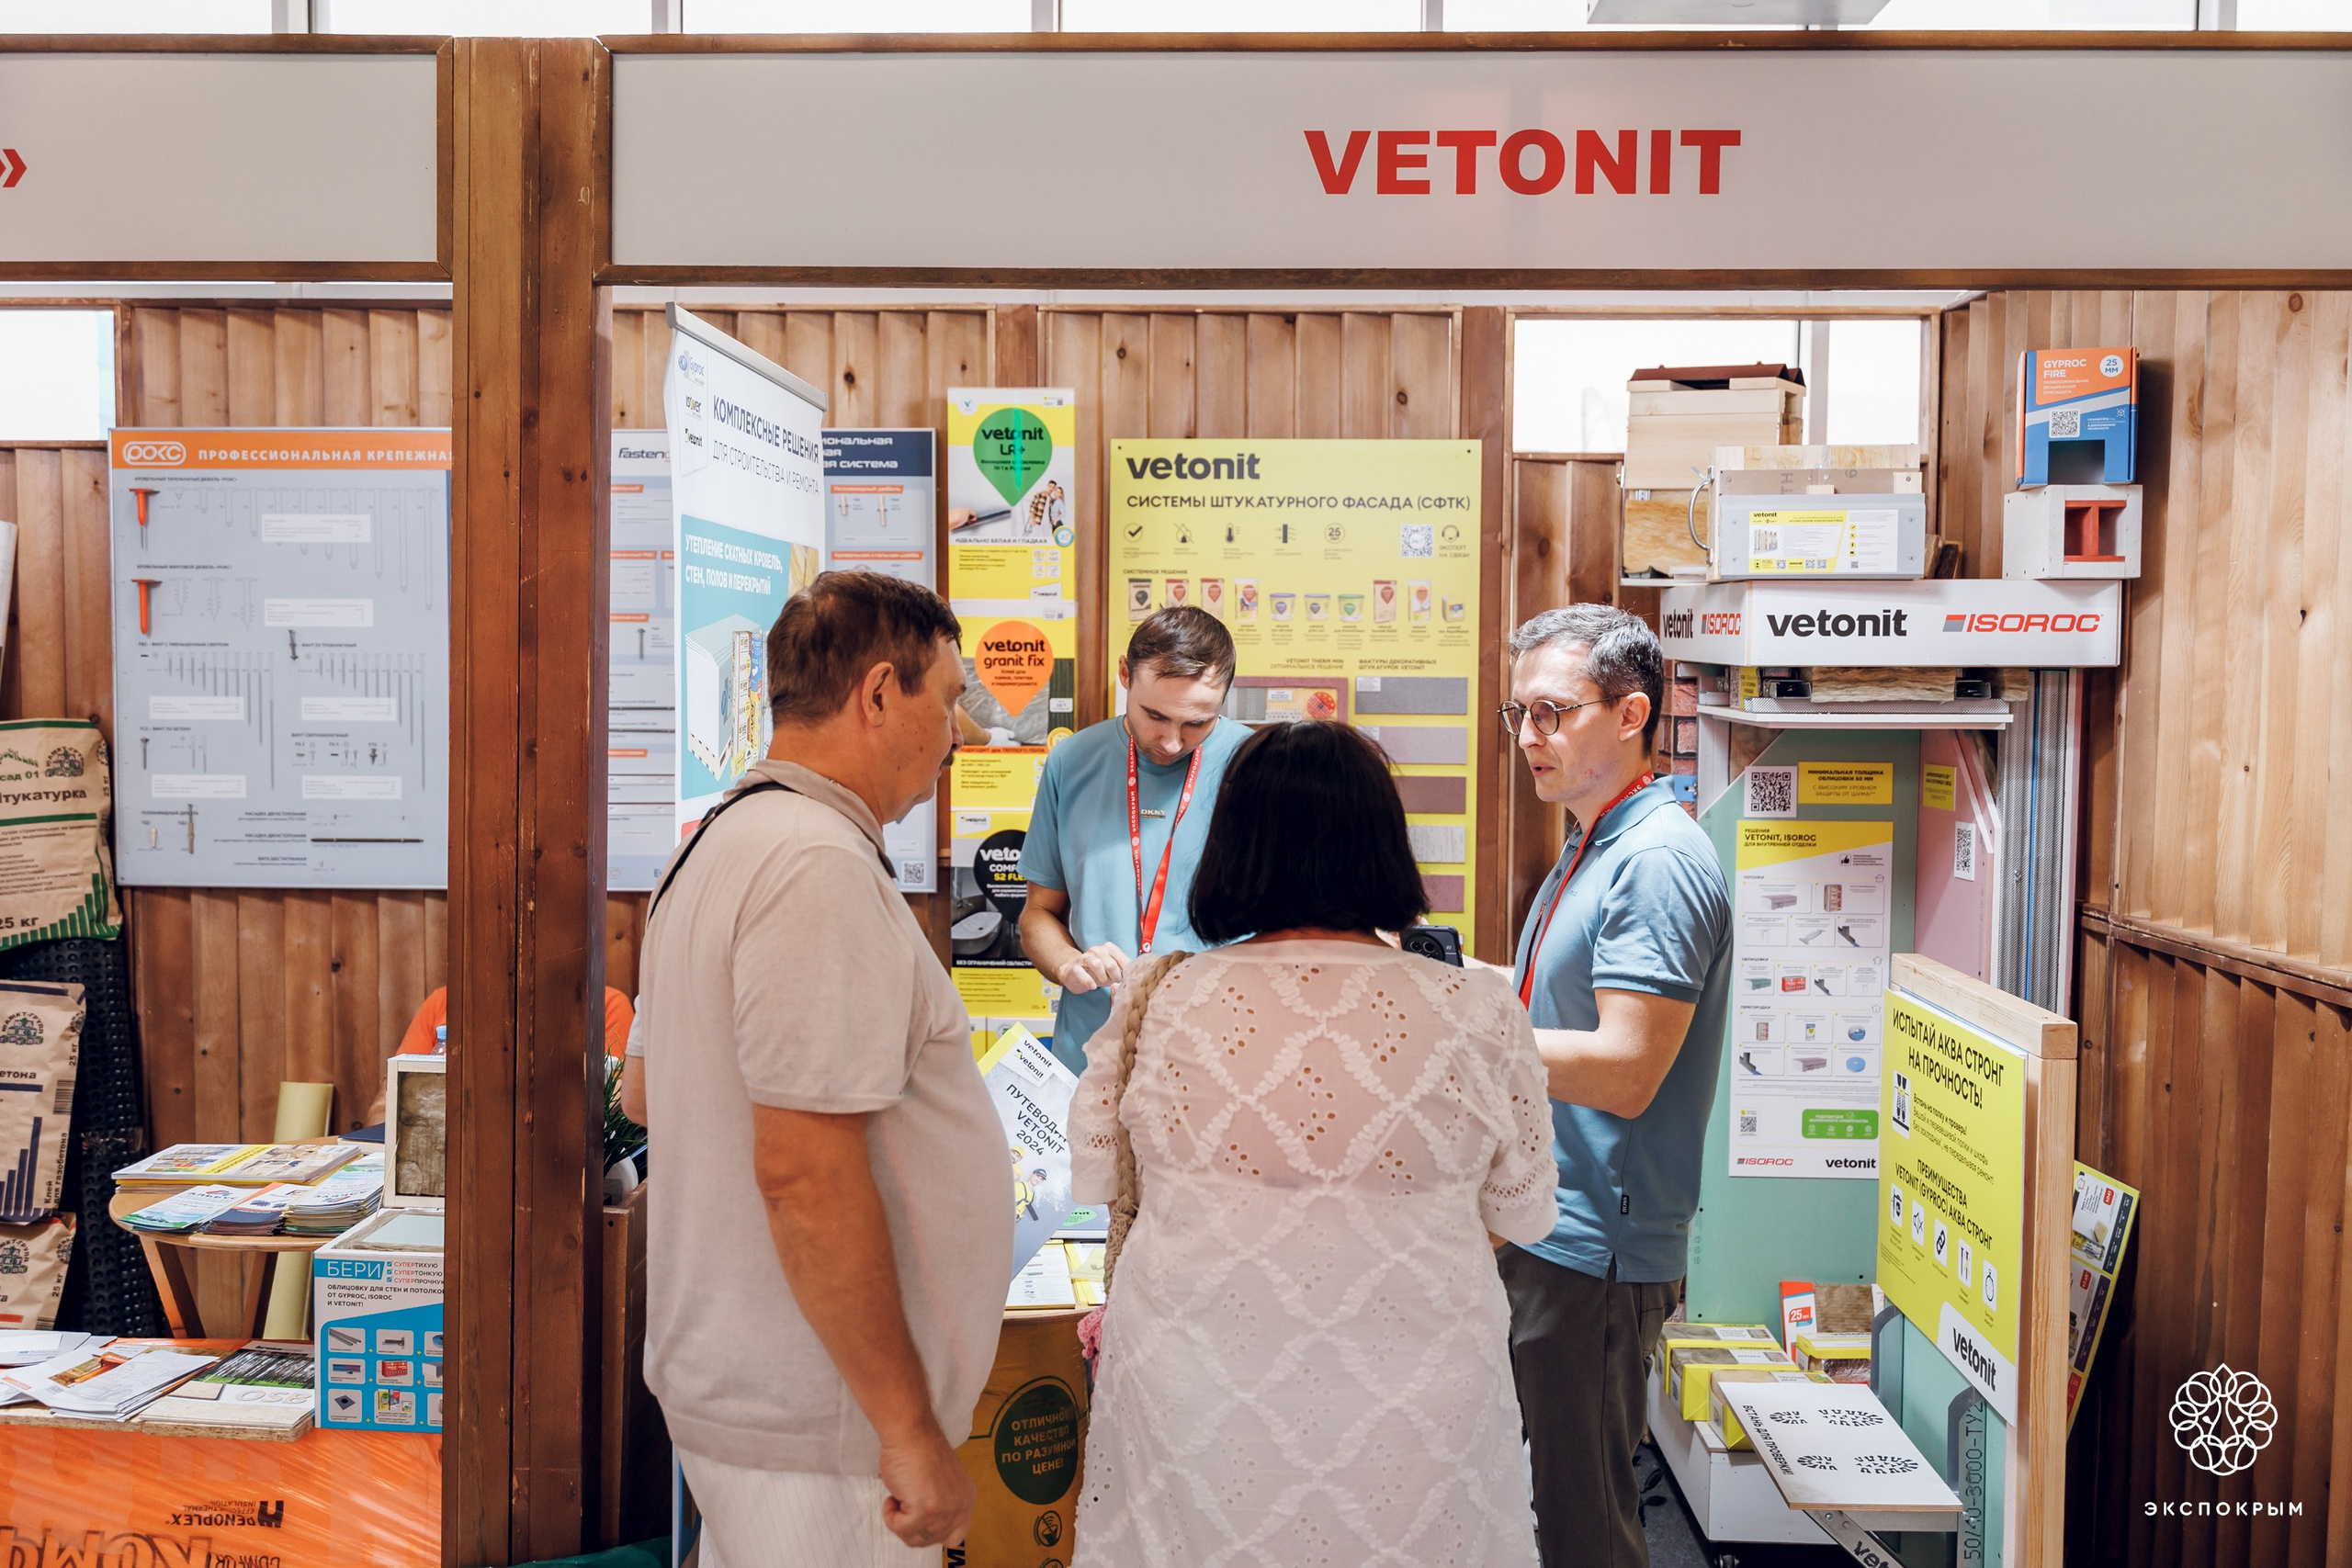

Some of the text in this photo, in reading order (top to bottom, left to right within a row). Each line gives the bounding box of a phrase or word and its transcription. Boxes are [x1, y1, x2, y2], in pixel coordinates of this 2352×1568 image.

[1303, 129, 1741, 196] VETONIT
[2043, 358, 2087, 368] GYPROC
[2106, 358, 2118, 367] 25
[2043, 369, 2066, 378] FIRE
[713, 394, 819, 464] КОМПЛЕКСНЫЕ РЕШЕНИЯ
[981, 427, 1044, 440] vetonit
[198, 449, 362, 462] ПРОФЕССИОНАЛЬНАЯ
[713, 440, 820, 496] ДЛЯ СТРОИТЕЛЬСТВА И РЕМОНТА
[1126, 453, 1261, 479] vetonit
[1126, 495, 1471, 512] СИСТЕМЫ ШТУКАТУРНОГО ФАСАДА (СФТК)
[1328, 527, 1340, 537] 25
[684, 533, 783, 573] УТЕПЛЕНИЕ СКАТНЫХ КРОВЕЛЬ,
[684, 564, 706, 588] СТЕН,
[706, 570, 728, 587] ПОЛОВ
[732, 573, 771, 595] ПЕРЕКРЫТИЙ
[1662, 608, 1694, 639] vetonit
[1706, 612, 1742, 636] ISOROC
[1766, 609, 1908, 637] vetonit
[1966, 613, 2102, 633] ISOROC
[983, 639, 1046, 652] vetonit
[983, 654, 1045, 669] granit fix
[0, 771, 40, 782] сад 01
[0, 788, 87, 806] тукатурка
[1745, 833, 1782, 842] VETONIT,
[979, 847, 1021, 862] veto
[989, 863, 1018, 872] COMF
[994, 873, 1006, 881] S2
[20, 917, 40, 927] кг
[1023, 1039, 1053, 1068] vetonit
[1893, 1008, 2005, 1088] ИСПЫТАЙ АКВА СТРОНГ
[69, 1053, 77, 1066] 25
[0, 1069, 37, 1080] етона
[1908, 1045, 1921, 1073] НА
[1922, 1055, 1983, 1110] ПРОЧНОСТЬ!
[1006, 1083, 1067, 1143] ПУТЕВОД
[1016, 1110, 1066, 1155] VETONIT
[1015, 1129, 1044, 1156] 2024
[56, 1132, 68, 1188] газобетона
[1746, 1157, 1793, 1167] ISOROC
[1826, 1157, 1877, 1168] vetonit
[44, 1179, 53, 1204] Клей
[1917, 1158, 1968, 1210] ПРЕИМУЩЕСТВА
[1894, 1162, 1993, 1251] VETONIT (GYPROC) АКВА СТРОНГ
[327, 1261, 381, 1279] БЕРИ
[51, 1286, 61, 1298] 25
[327, 1284, 368, 1292] ОБЛИЦОВКУ
[1790, 1310, 1803, 1322] 25
[1952, 1326, 1996, 1393] vetonit
[234, 1389, 312, 1405] OSB
[1013, 1426, 1070, 1447] КАЧЕСТВО
[1742, 1404, 1794, 1476] ВСТАНЬ ДЛЯ ПРОВЕРКИ!
[1001, 1438, 1077, 1463] ПО РАЗУМНОЙ
[1032, 1458, 1064, 1475] ЦЕНЕ!
[182, 1504, 218, 1512] THERMAL
[171, 1513, 256, 1527] PENOPLEX
